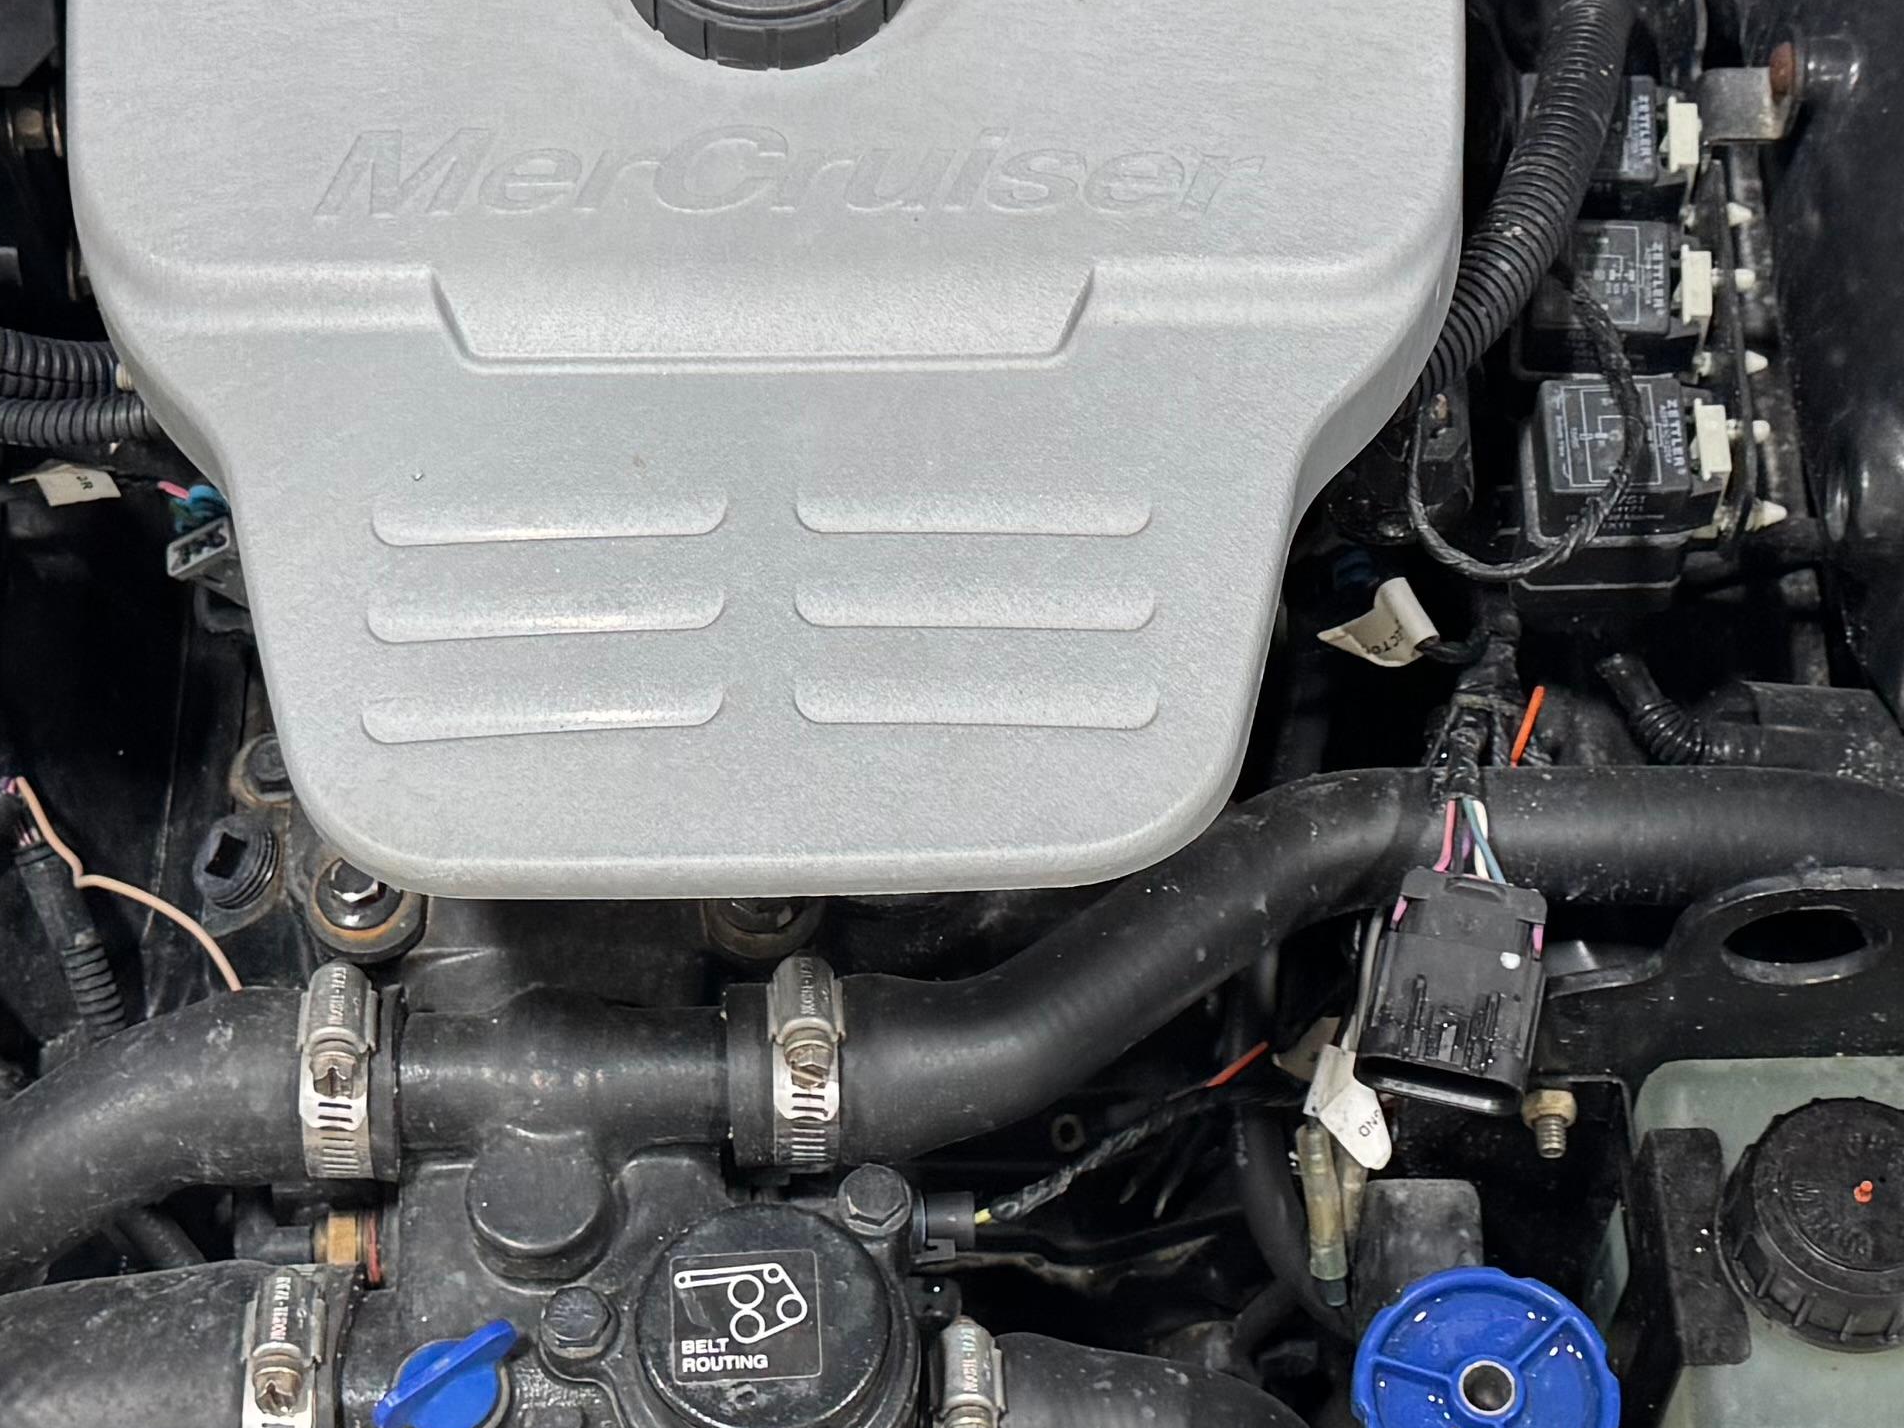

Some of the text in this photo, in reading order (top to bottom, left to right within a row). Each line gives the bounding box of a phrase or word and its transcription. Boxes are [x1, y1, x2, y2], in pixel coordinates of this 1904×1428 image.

[312, 124, 1267, 220] MerCruiser
[1666, 398, 1685, 468] ZETTLER
[681, 1338, 730, 1355] BELT
[682, 1354, 769, 1373] ROUTING
